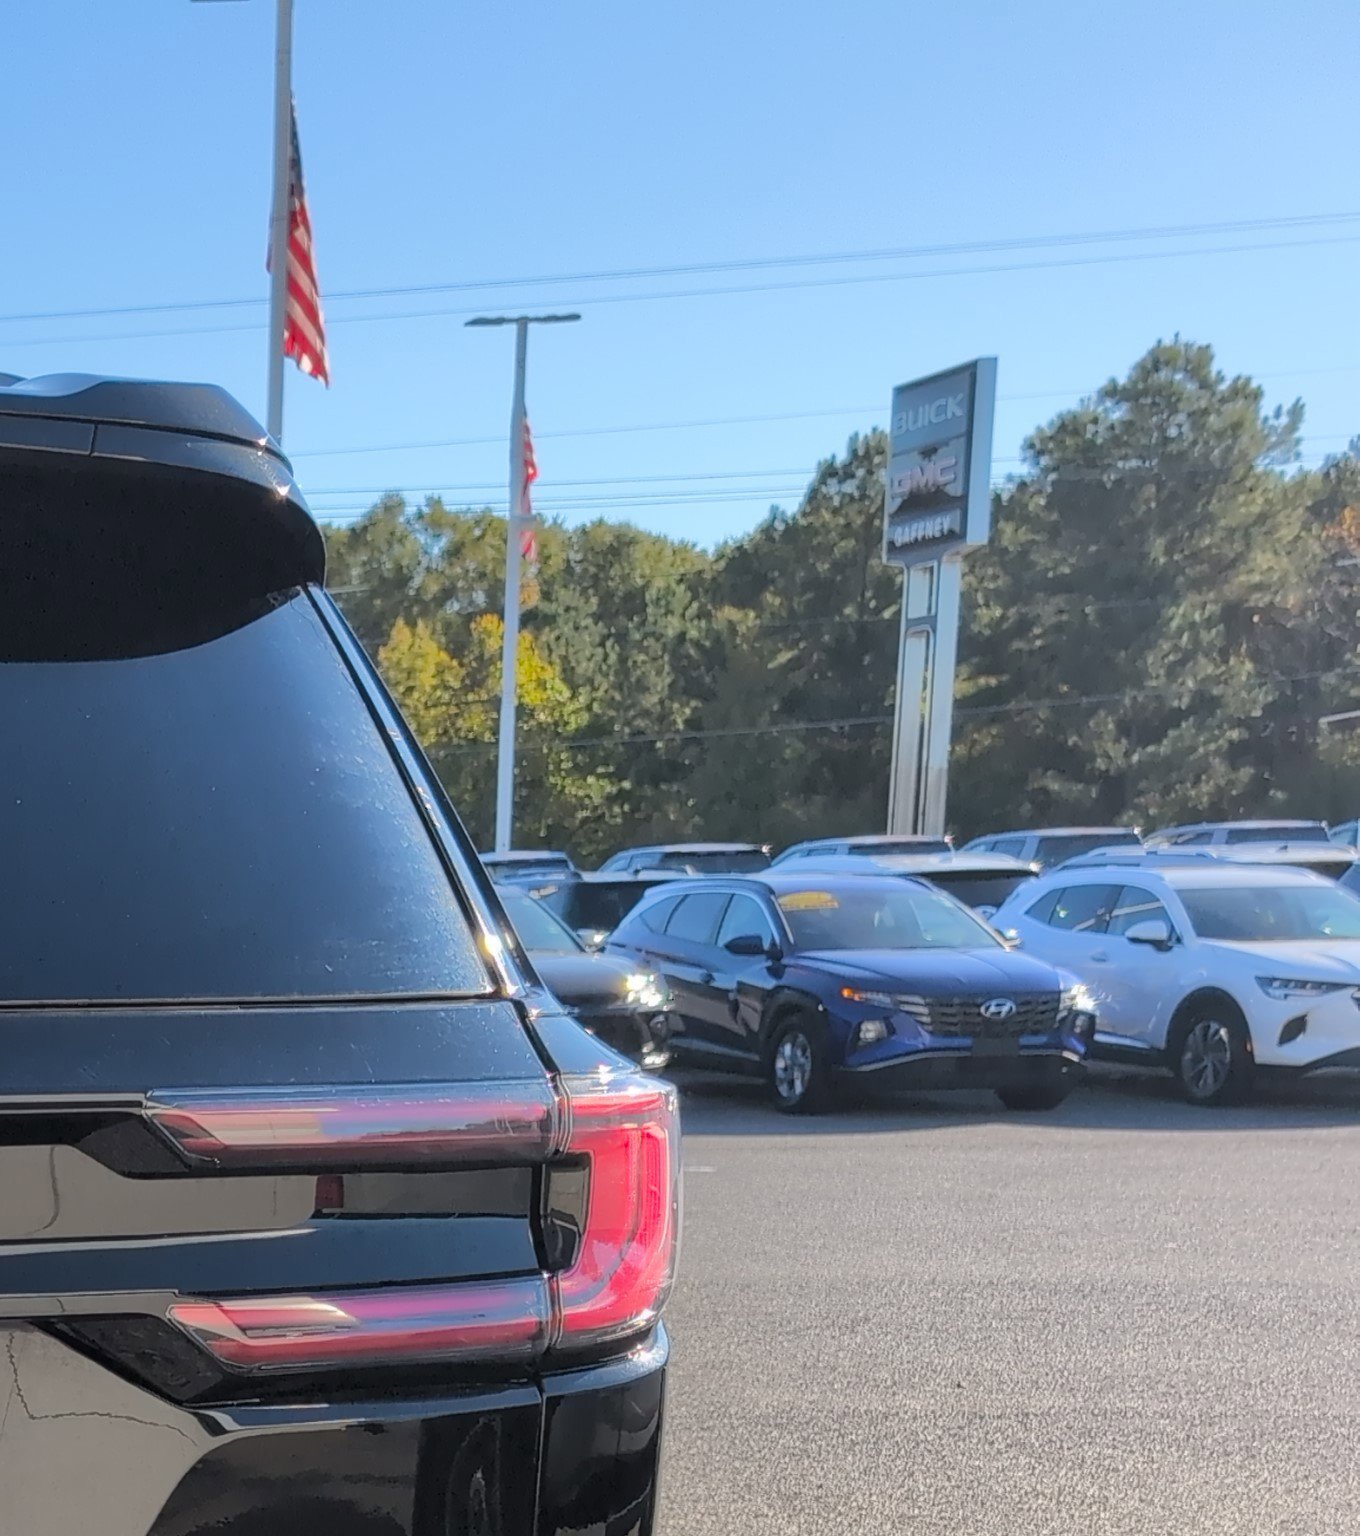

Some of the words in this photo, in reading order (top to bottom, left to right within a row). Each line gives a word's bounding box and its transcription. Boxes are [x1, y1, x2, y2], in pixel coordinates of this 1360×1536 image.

[893, 393, 964, 436] BUICK
[890, 457, 957, 492] GMC
[893, 513, 952, 547] GAFFNEY
